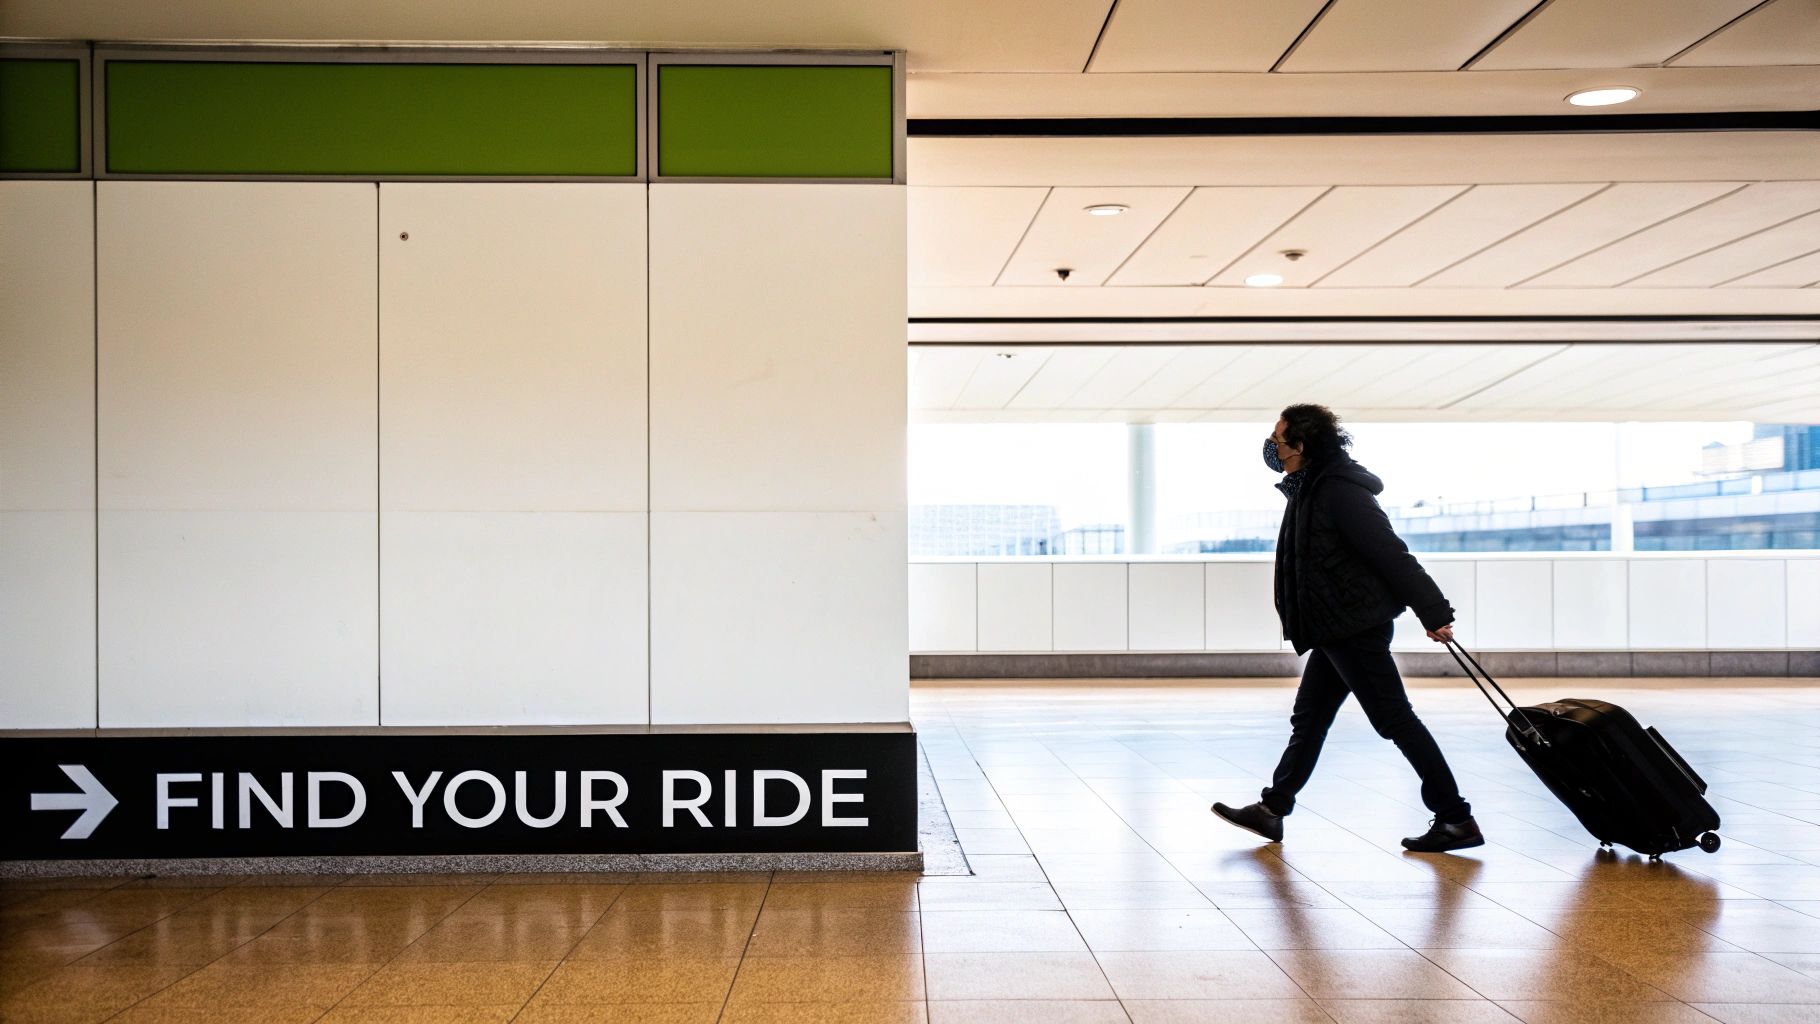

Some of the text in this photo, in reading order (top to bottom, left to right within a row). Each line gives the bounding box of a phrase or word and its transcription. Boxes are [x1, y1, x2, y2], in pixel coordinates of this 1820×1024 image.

[156, 769, 869, 829] FIND YOUR RIDE
